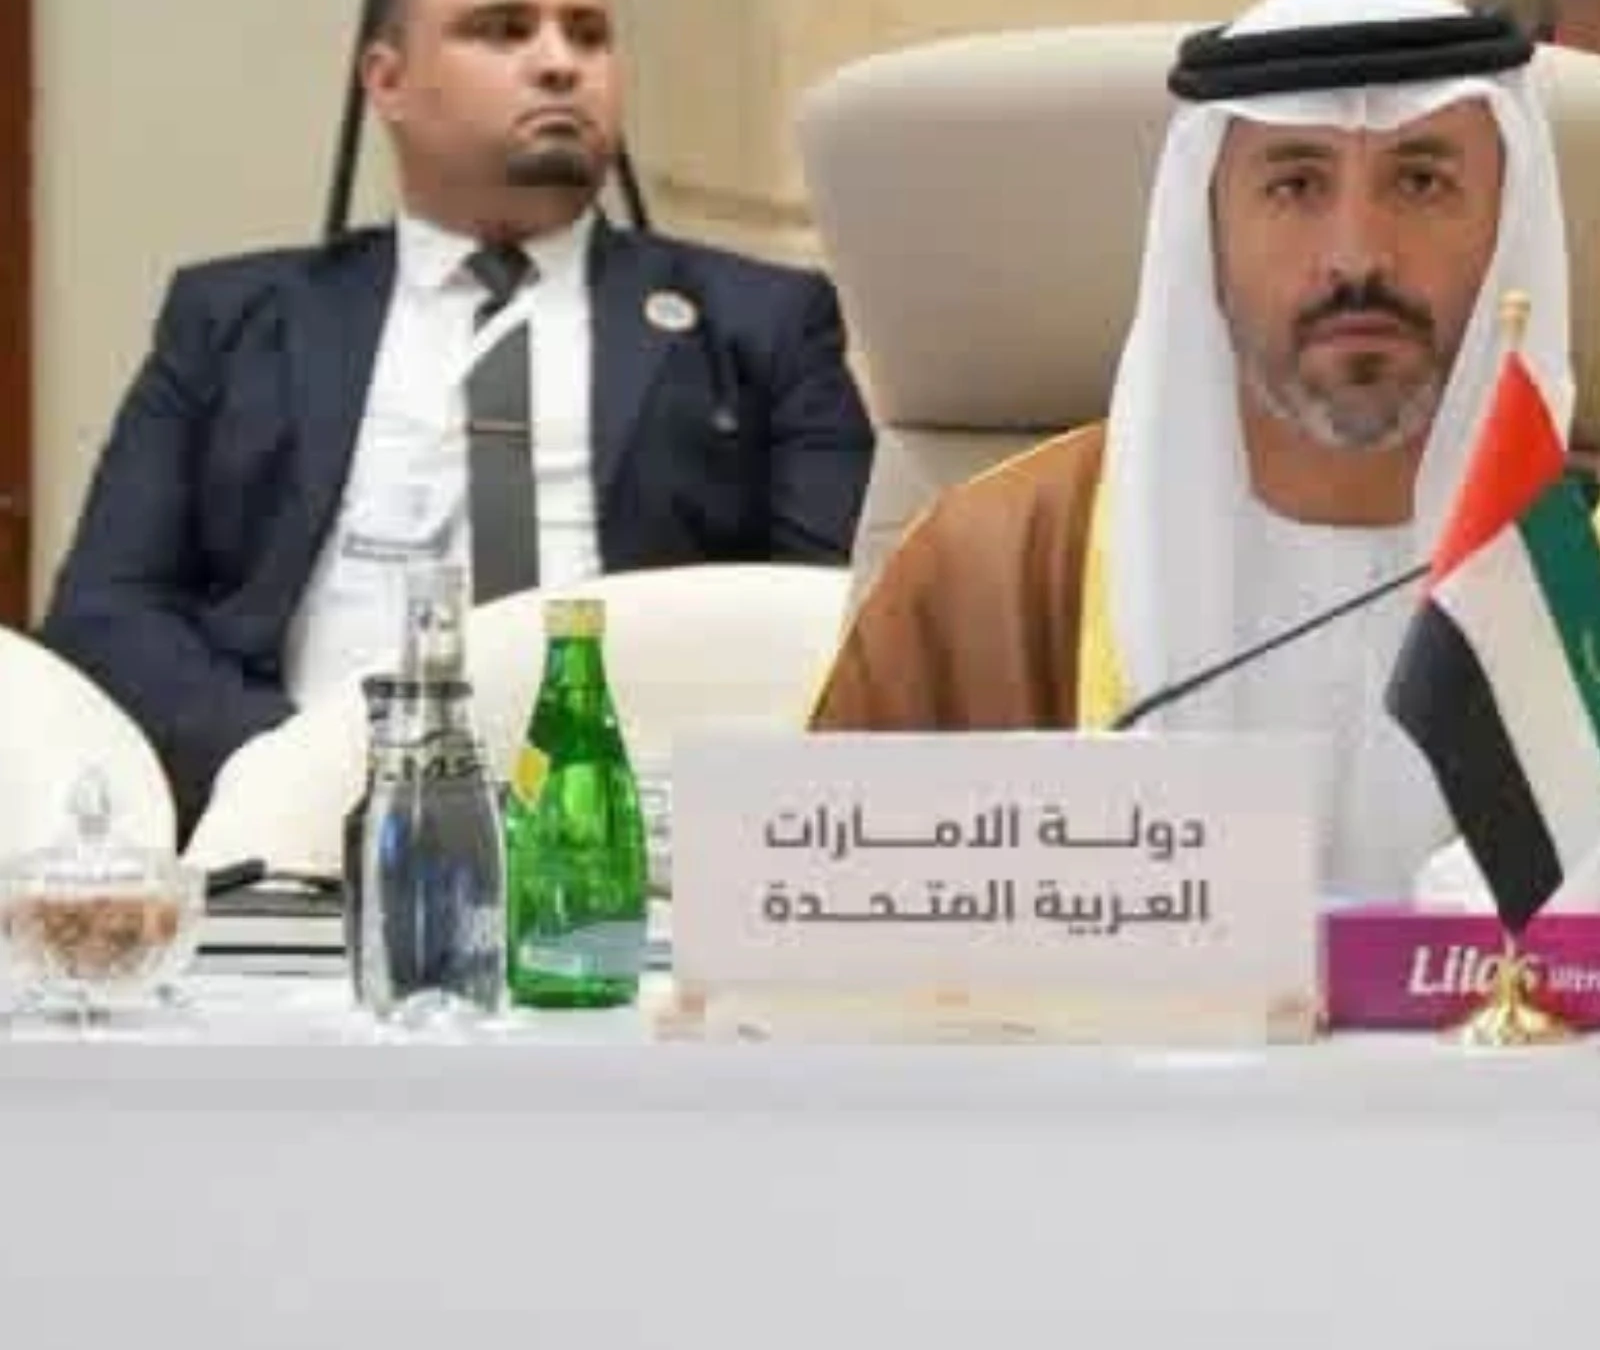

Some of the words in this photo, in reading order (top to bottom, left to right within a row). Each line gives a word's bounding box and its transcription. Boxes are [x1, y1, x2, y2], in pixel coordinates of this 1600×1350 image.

[1037, 805, 1206, 862] دولة
[762, 879, 1016, 924] المتحدة
[1033, 879, 1210, 936] العربية
